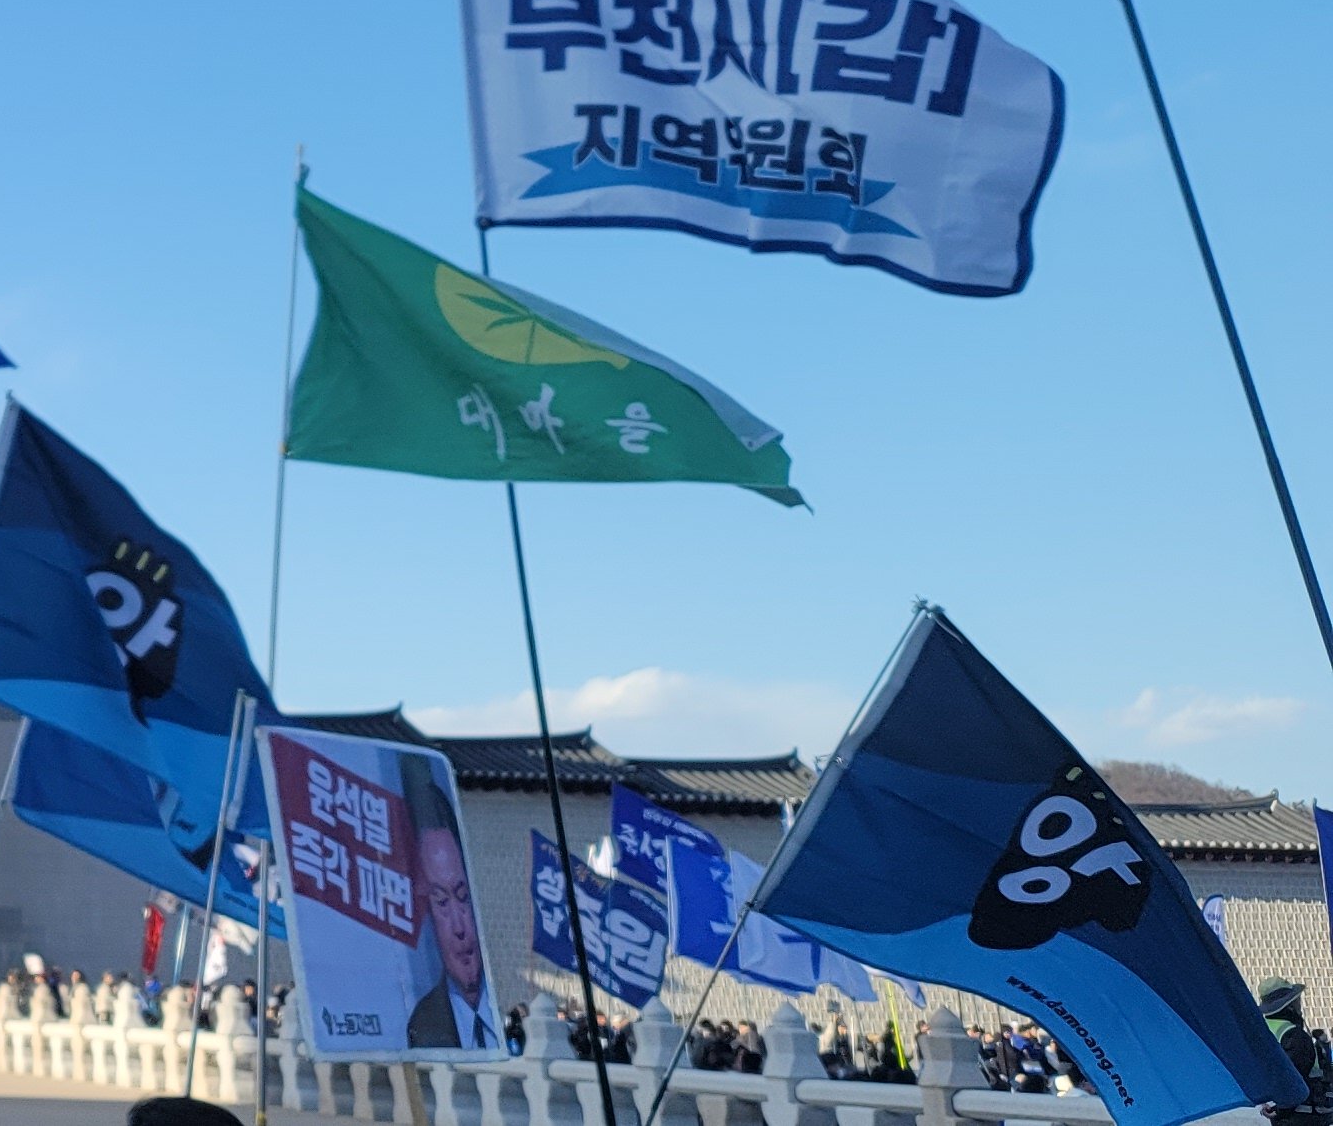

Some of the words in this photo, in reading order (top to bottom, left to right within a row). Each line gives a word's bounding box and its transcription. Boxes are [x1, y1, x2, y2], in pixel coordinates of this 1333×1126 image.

[307, 759, 392, 856] 윤석열
[291, 820, 352, 905] 즉각
[357, 855, 414, 935] 파면
[1005, 976, 1135, 1108] www.damoang.net
